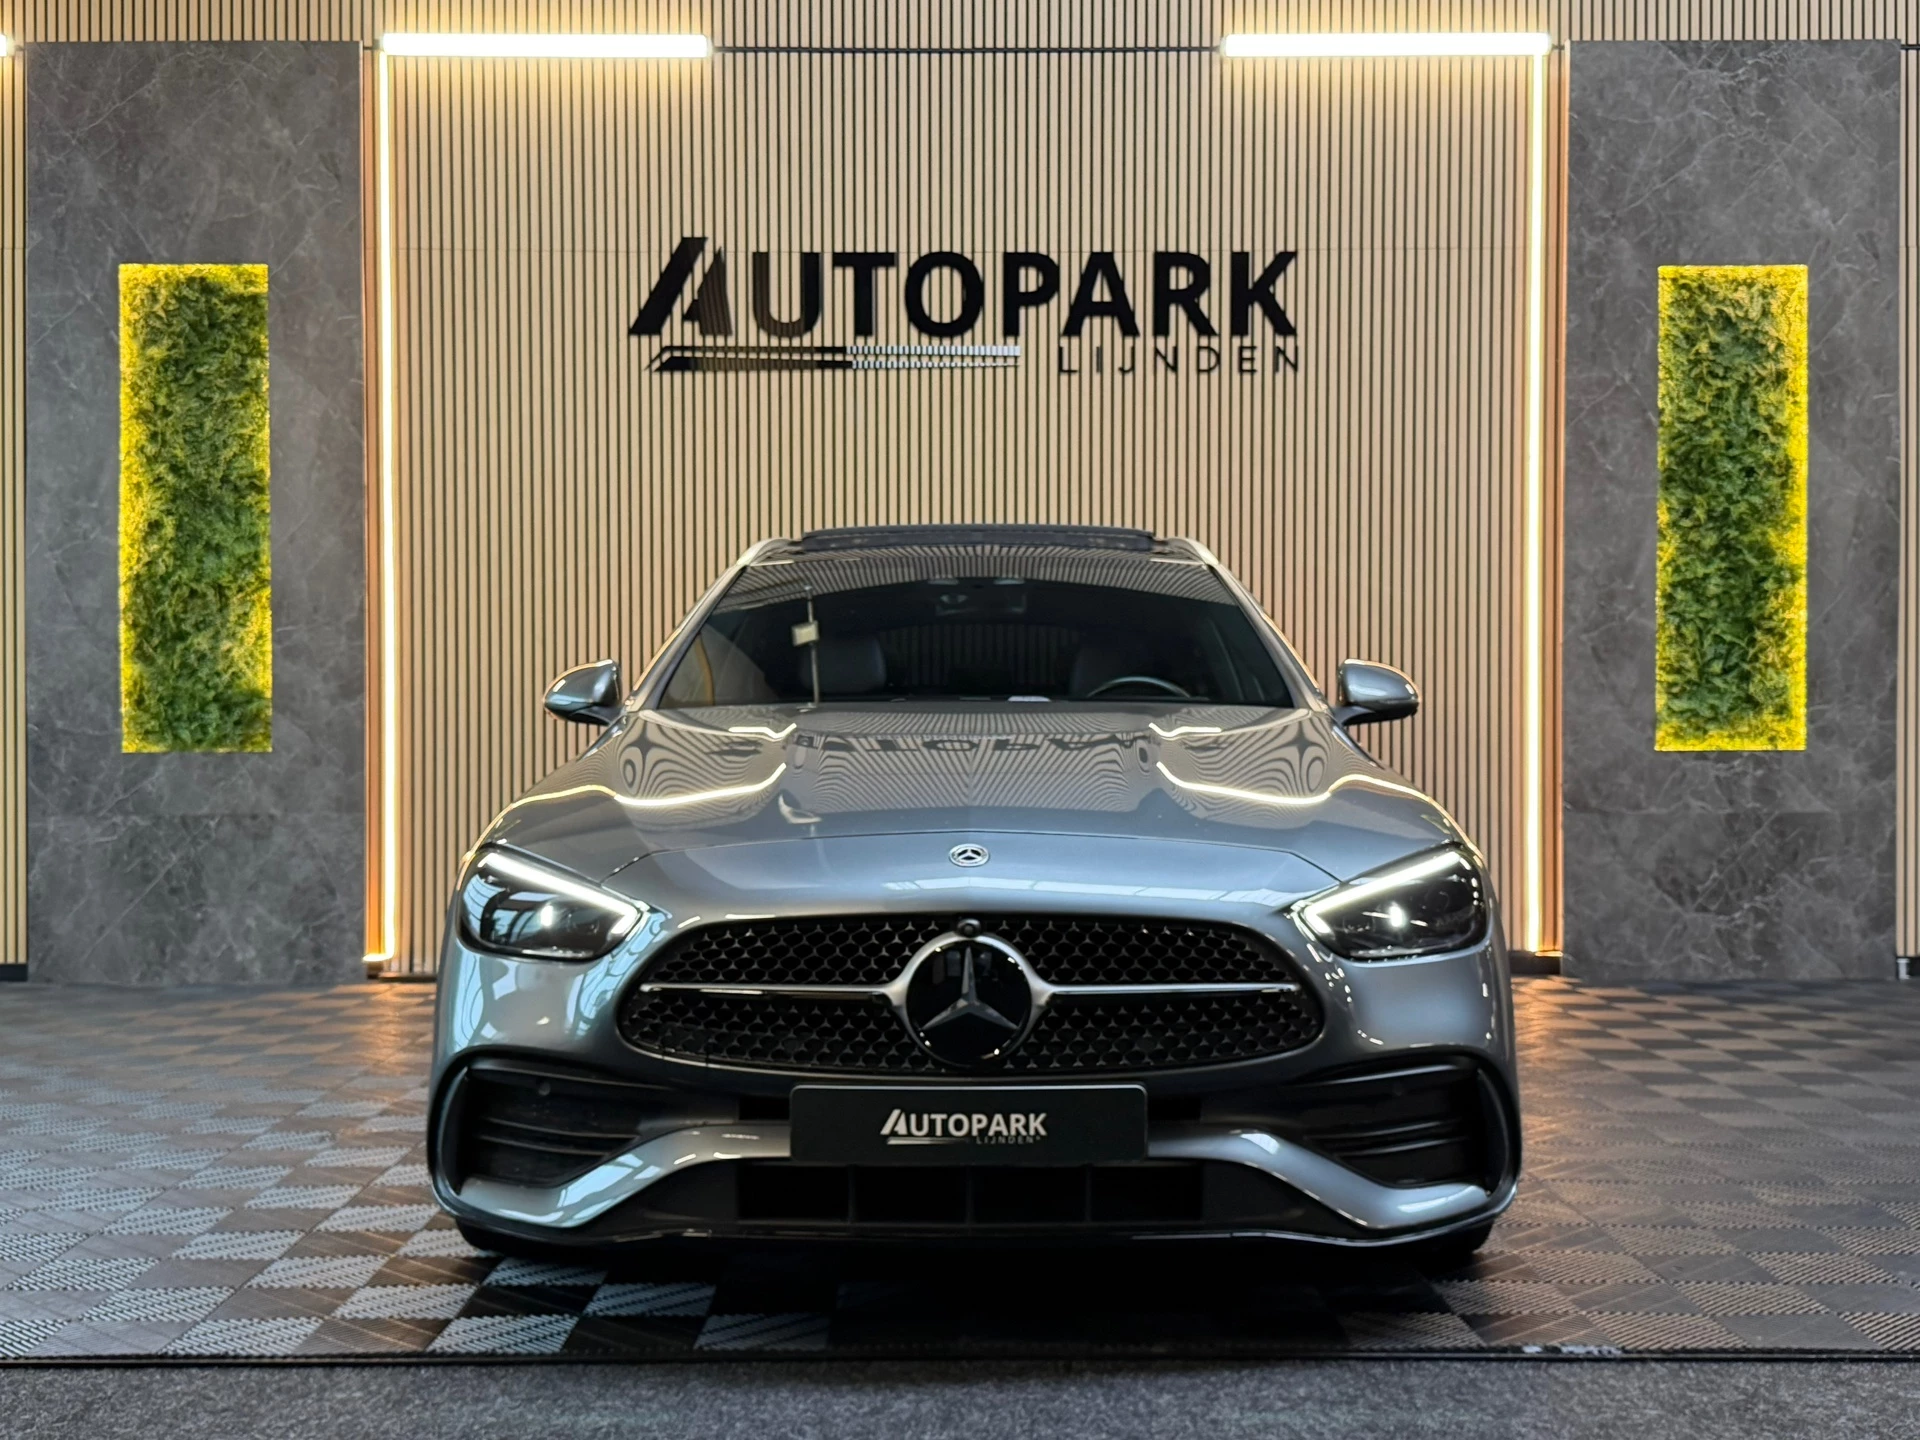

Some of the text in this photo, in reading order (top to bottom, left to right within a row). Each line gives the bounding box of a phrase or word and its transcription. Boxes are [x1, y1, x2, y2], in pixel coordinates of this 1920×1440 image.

[629, 236, 1298, 338] AUTOPARK
[1058, 345, 1298, 373] LIJNDEN
[880, 1109, 1047, 1136] AUTOPARK
